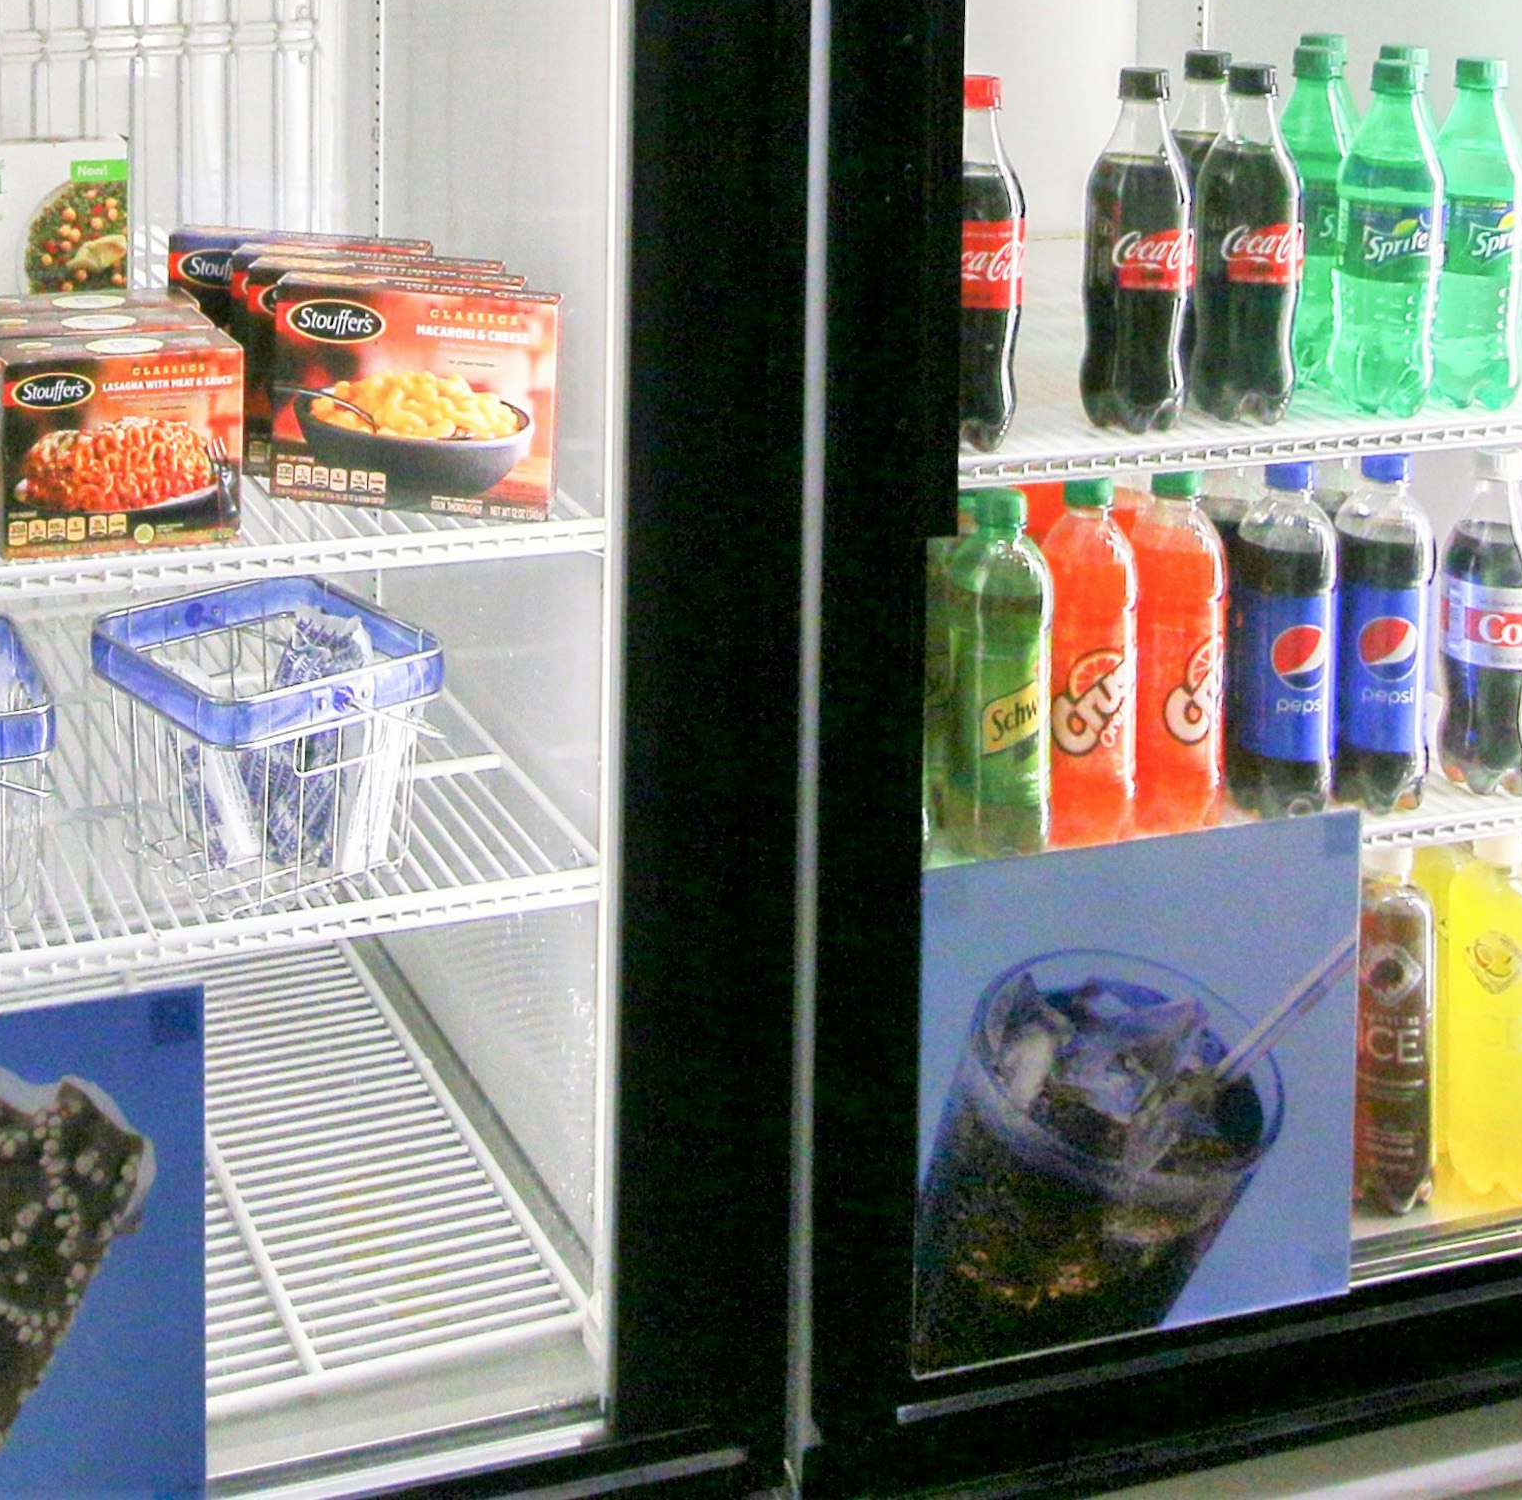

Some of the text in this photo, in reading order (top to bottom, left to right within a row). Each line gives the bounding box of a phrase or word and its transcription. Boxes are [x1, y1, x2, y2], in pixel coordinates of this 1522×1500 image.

[78, 165, 107, 177] New!
[1364, 225, 1430, 263] Sprite
[298, 308, 374, 336] Stouffer's
[429, 308, 520, 327] CLASSICS
[415, 323, 531, 345] MACARONI & CHEESE
[131, 363, 206, 376] CLASSICS
[21, 380, 85, 402] Stouffer's
[102, 375, 233, 393] LASAGNA WITH MEAT & SAUCE
[1361, 686, 1415, 705] pepsi
[1276, 697, 1324, 714] peps
